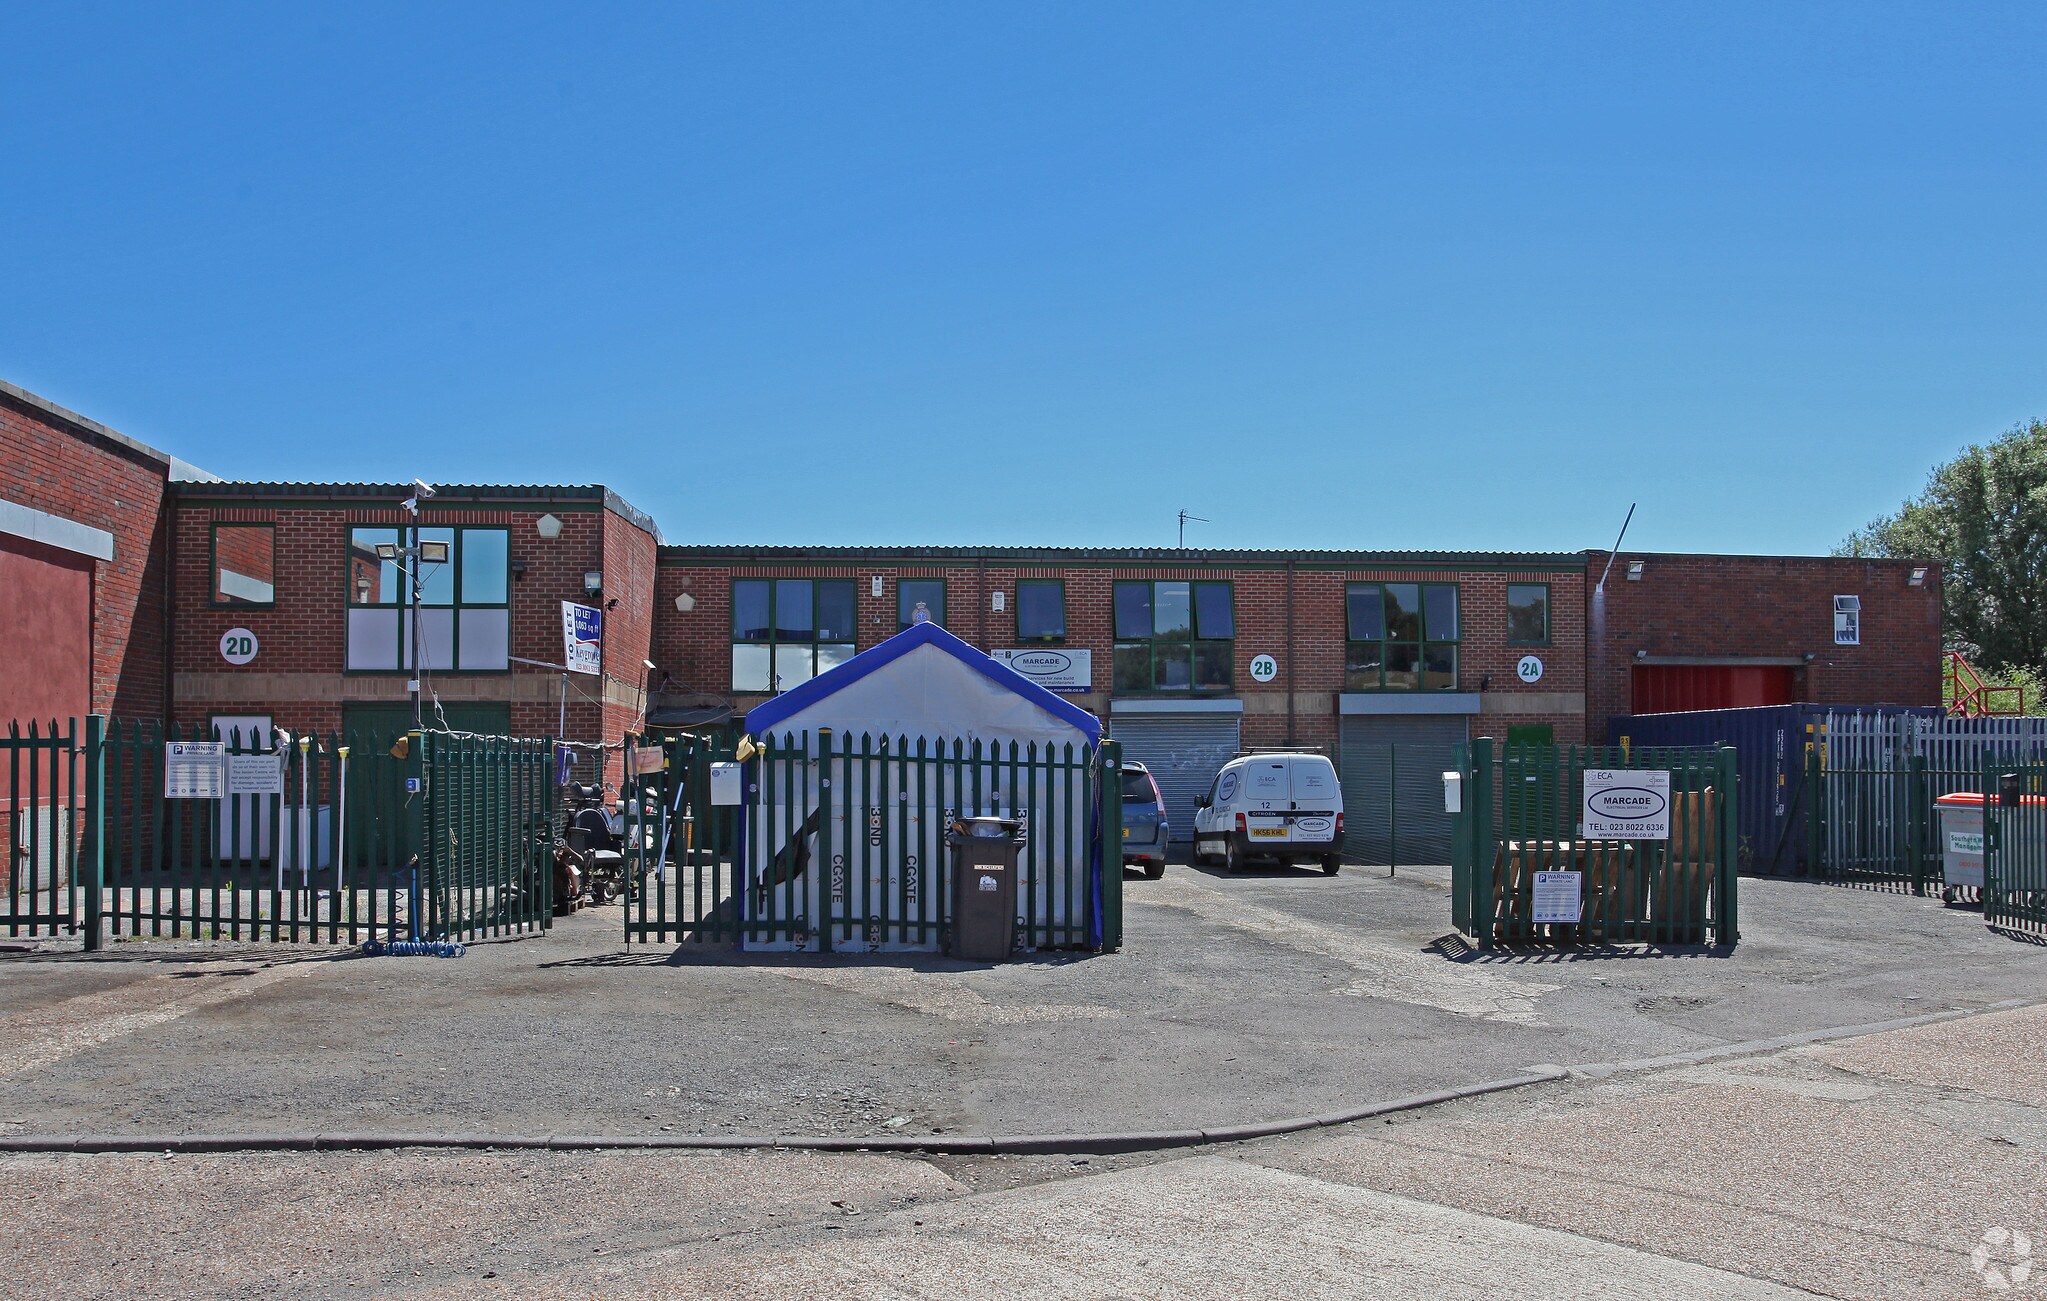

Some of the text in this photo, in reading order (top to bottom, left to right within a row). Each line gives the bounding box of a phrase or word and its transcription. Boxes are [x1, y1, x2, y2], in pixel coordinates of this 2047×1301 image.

[575, 608, 591, 619] TO LET
[226, 637, 252, 655] 2D
[568, 644, 574, 660] TO
[1254, 661, 1272, 675] 2B
[1522, 663, 1539, 676] 2A
[1597, 772, 1613, 780] ECA
